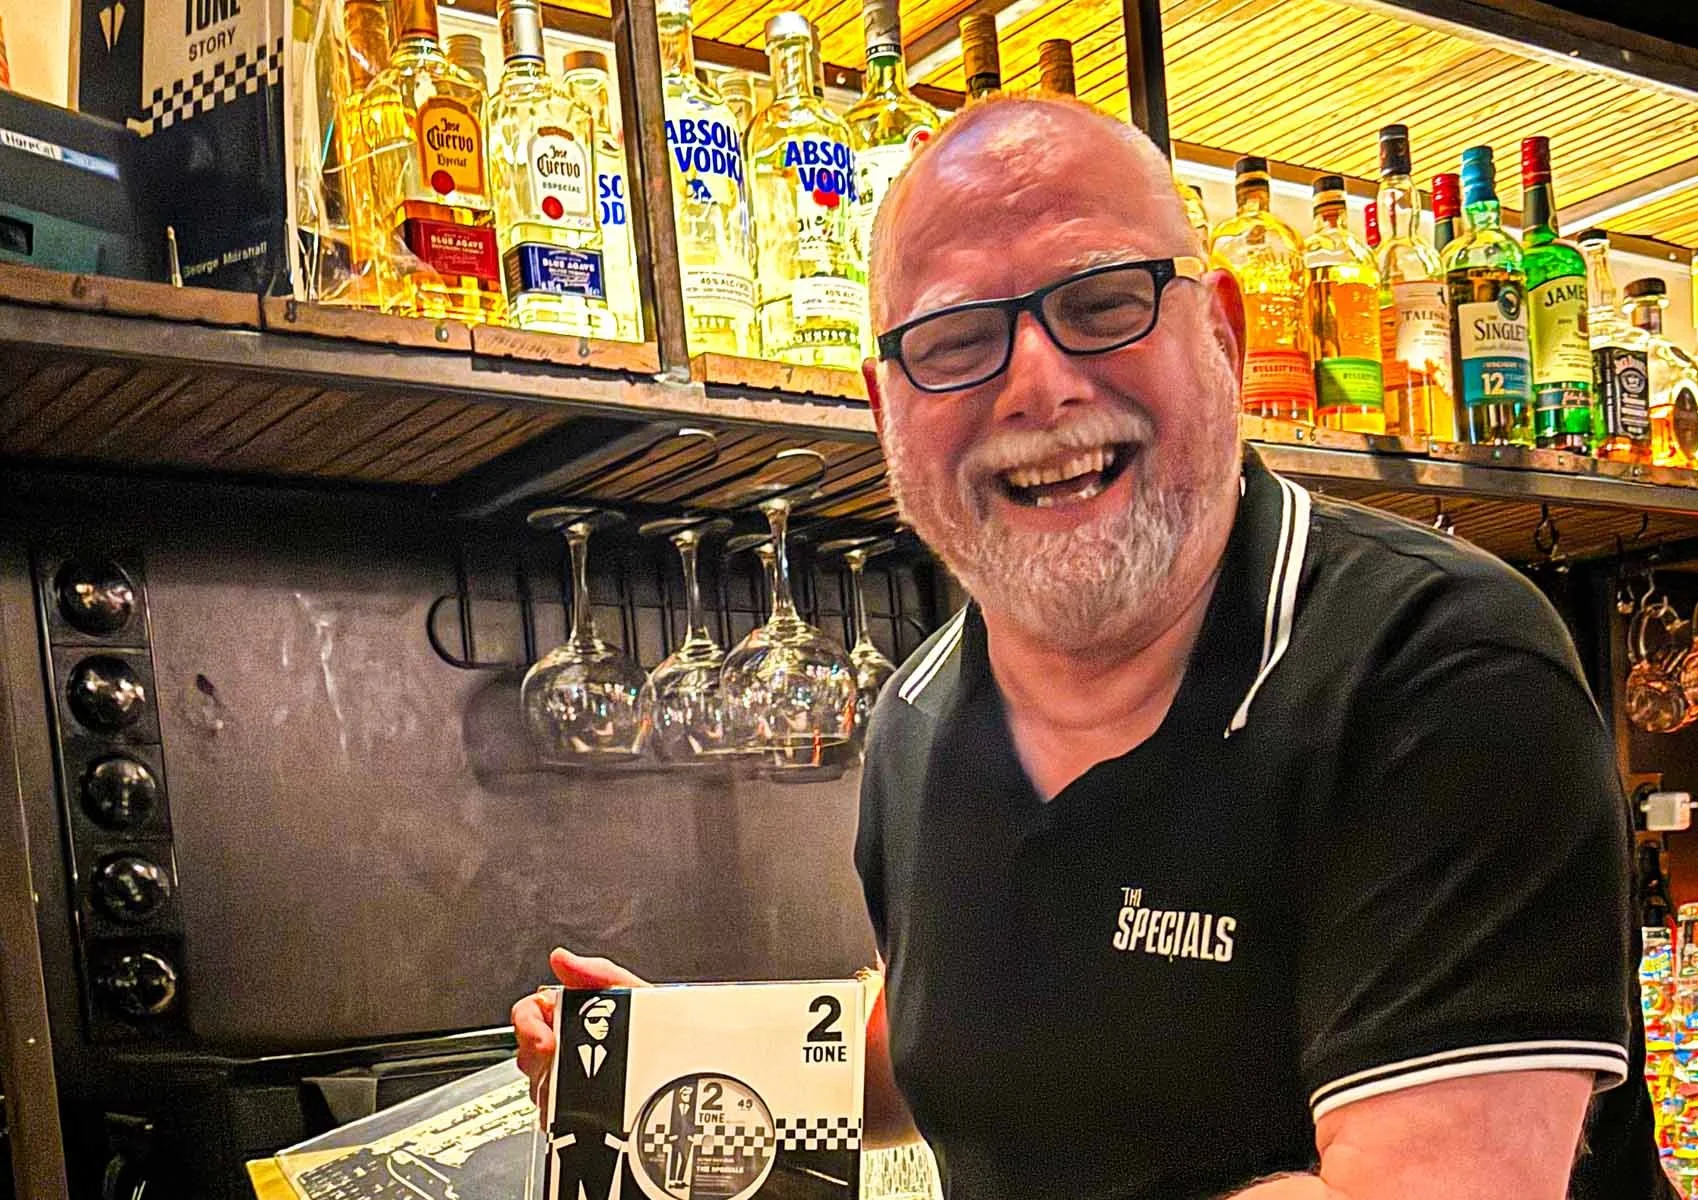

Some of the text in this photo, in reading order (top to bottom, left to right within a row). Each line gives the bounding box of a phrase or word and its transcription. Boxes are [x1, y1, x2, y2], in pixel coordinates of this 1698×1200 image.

[188, 27, 236, 61] STORY
[426, 125, 474, 152] Cuervo
[537, 153, 581, 178] Cuervo
[1481, 371, 1505, 396] 12
[1113, 907, 1237, 962] SPECIALS
[806, 995, 842, 1042] 2
[803, 1045, 847, 1063] TONE
[701, 1082, 723, 1111] 2
[699, 1112, 725, 1123] TONE
